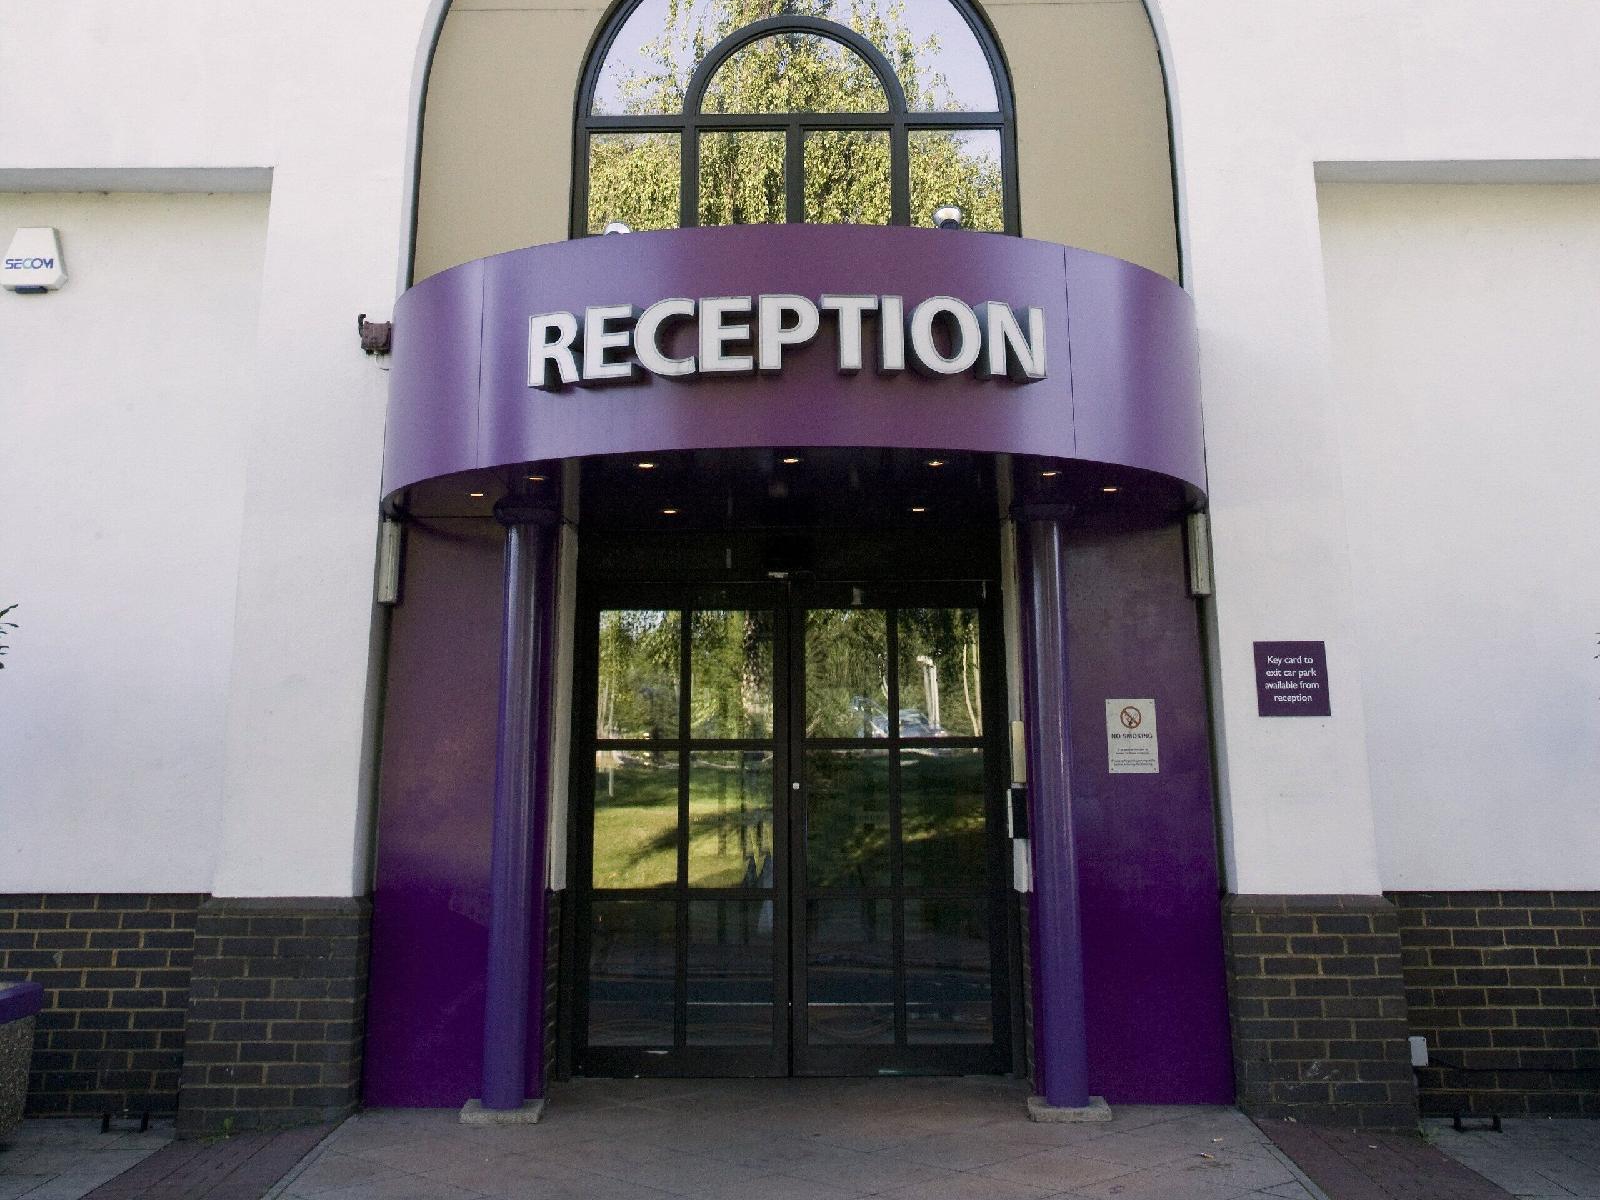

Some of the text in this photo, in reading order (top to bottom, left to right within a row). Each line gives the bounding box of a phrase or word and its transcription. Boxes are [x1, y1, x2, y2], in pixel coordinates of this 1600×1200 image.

[5, 257, 55, 270] SECOM
[527, 293, 1047, 390] RECEPTION
[1267, 655, 1314, 666] Key card to
[1265, 667, 1317, 679] exit car park
[1264, 680, 1320, 689] available from
[1273, 693, 1313, 703] reception
